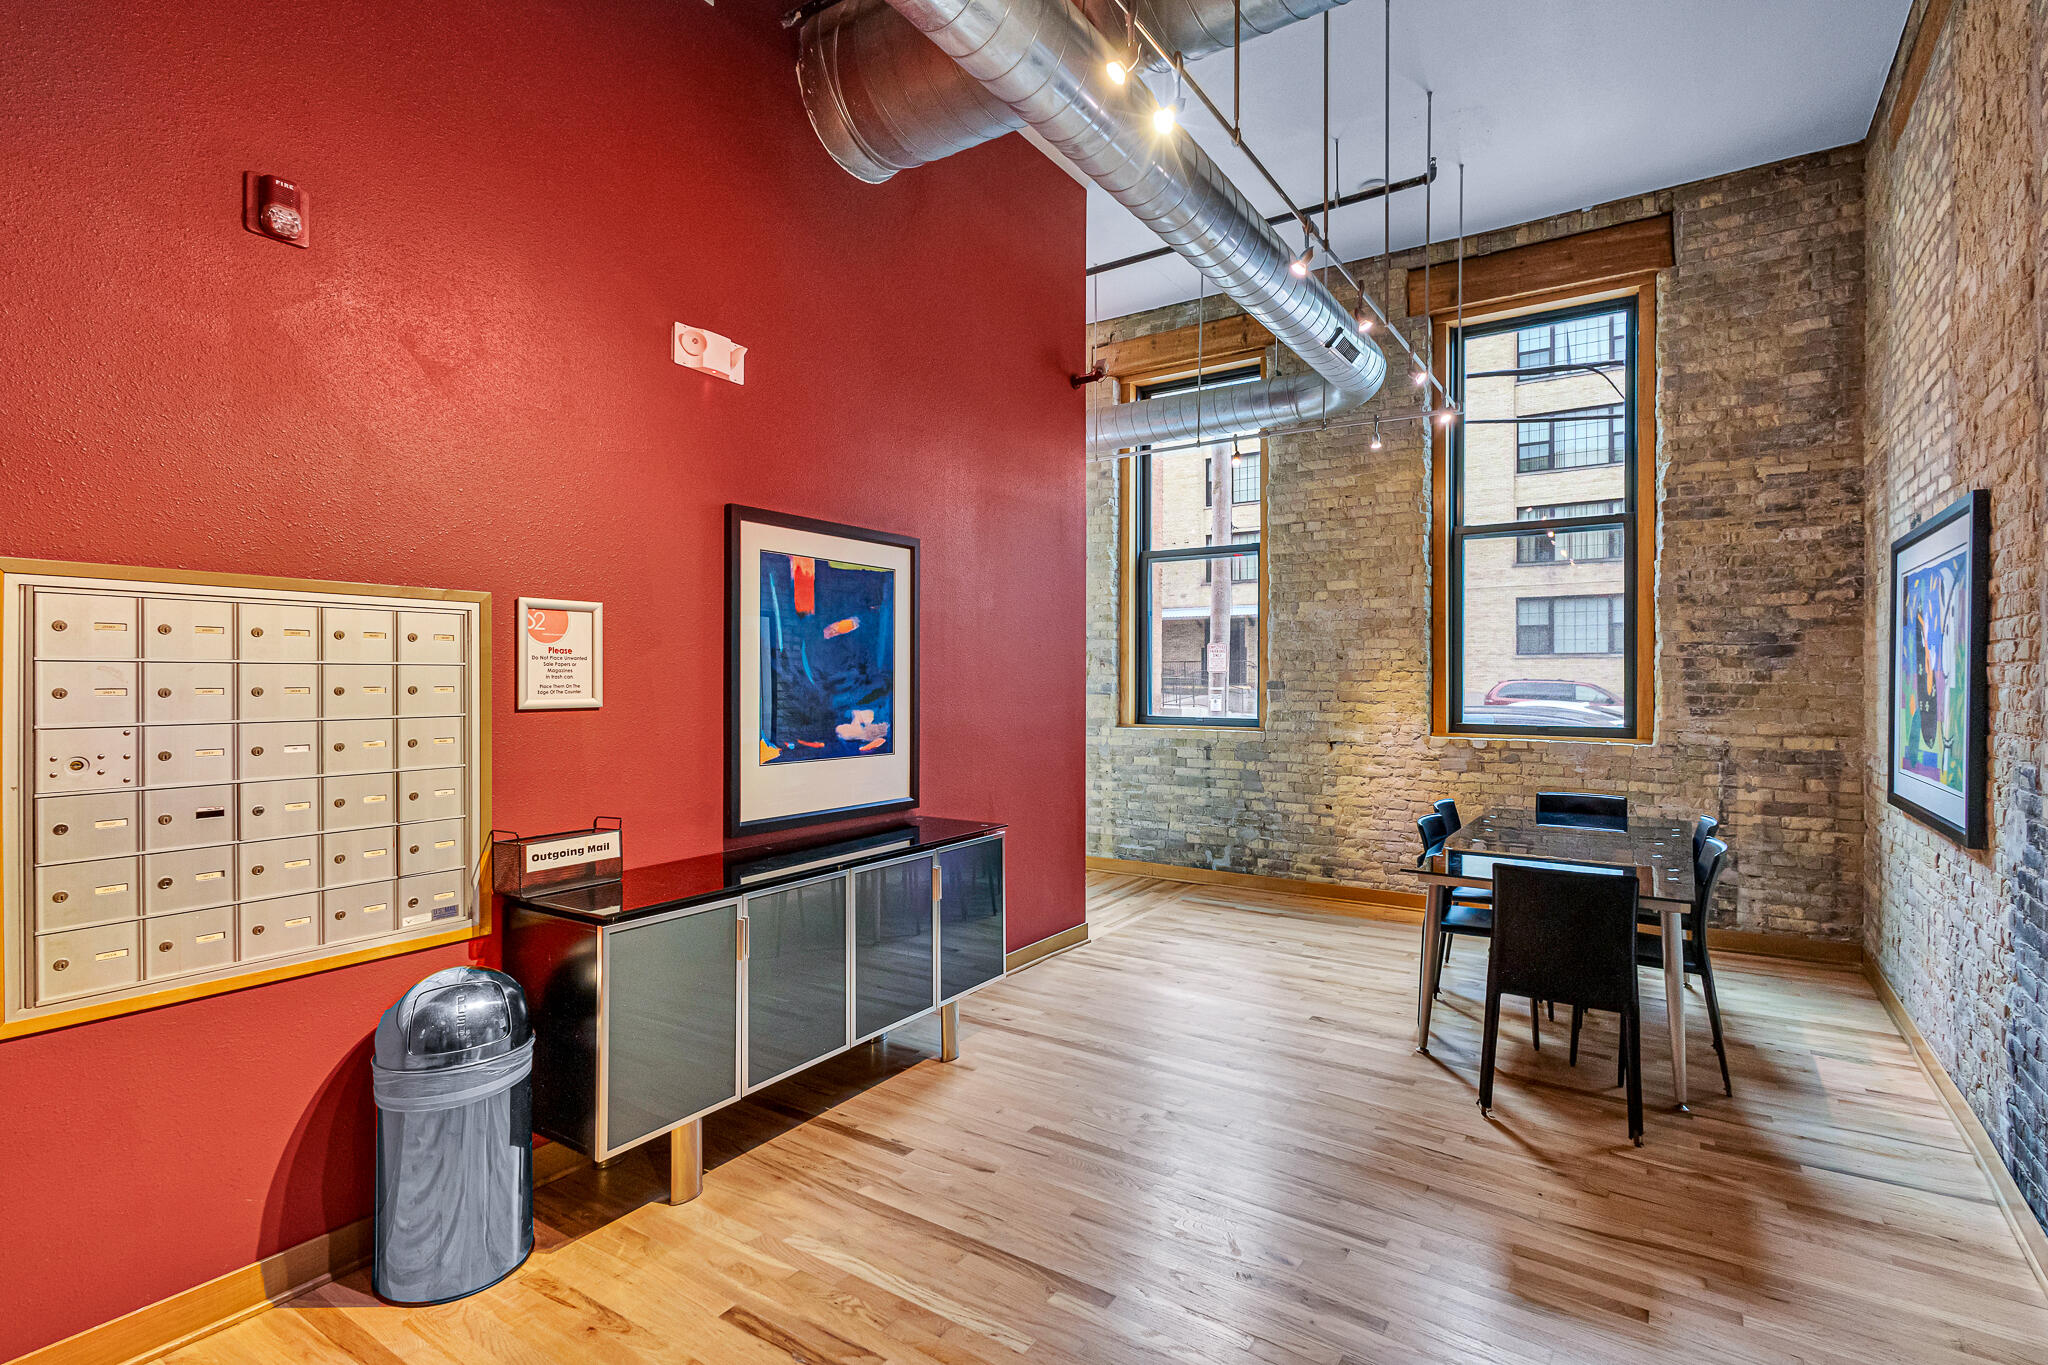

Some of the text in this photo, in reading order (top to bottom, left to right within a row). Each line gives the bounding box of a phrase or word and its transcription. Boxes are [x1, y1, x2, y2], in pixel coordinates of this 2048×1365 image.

[275, 179, 294, 191] FIRE
[548, 646, 573, 655] Please
[531, 842, 610, 862] Outgoing Mail
